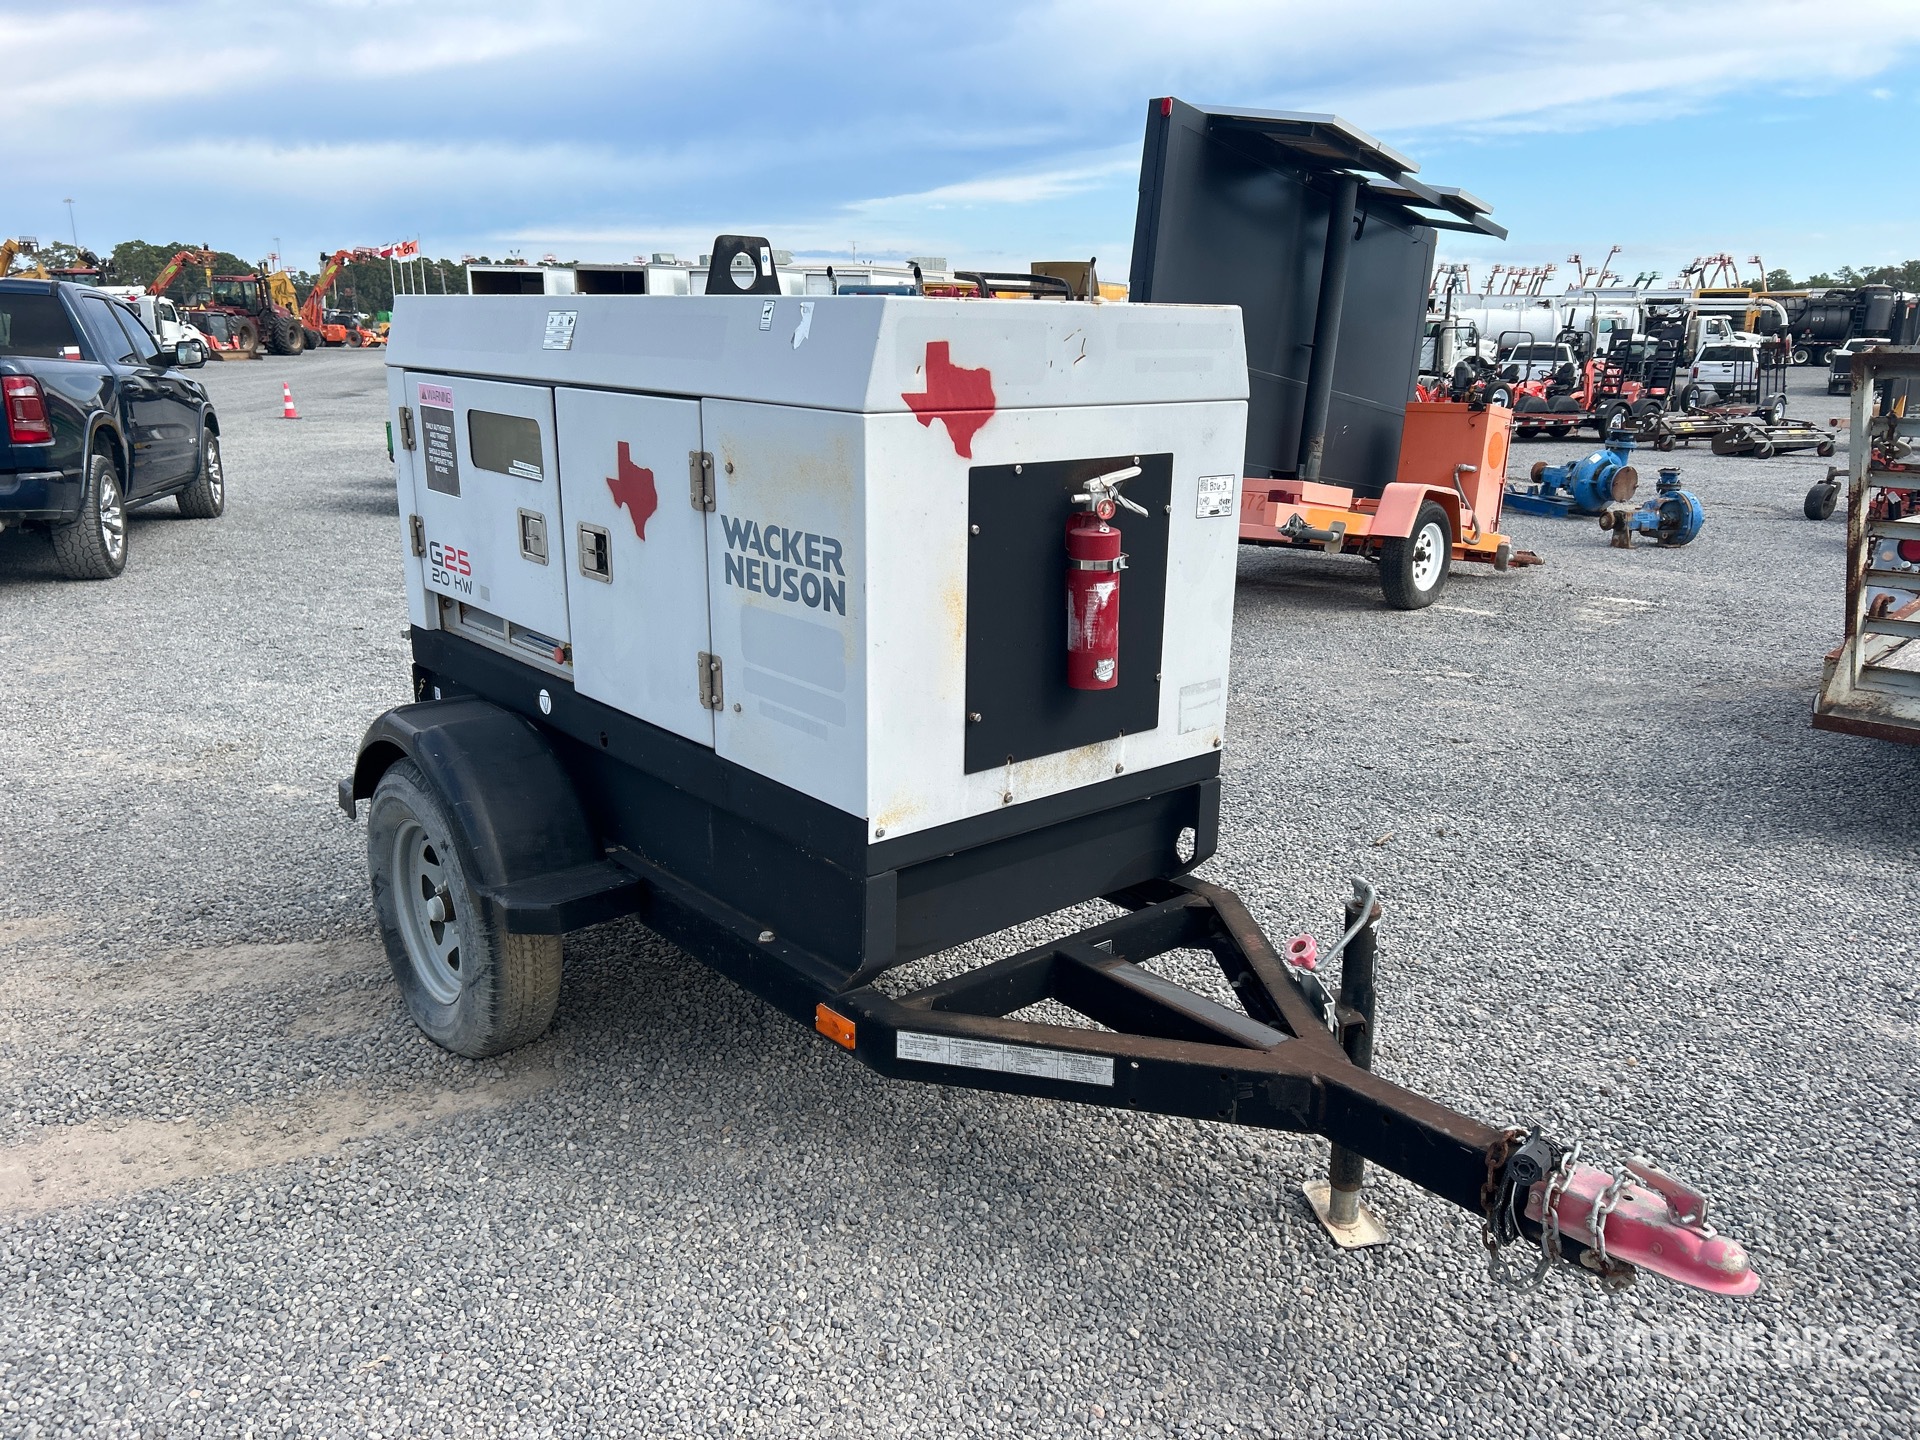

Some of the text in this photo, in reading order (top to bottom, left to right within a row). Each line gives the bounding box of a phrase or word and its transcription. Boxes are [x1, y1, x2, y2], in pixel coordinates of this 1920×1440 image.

[427, 389, 451, 404] WARNING
[429, 540, 472, 577] G25
[720, 514, 846, 577] WACKER
[431, 567, 450, 587] 20
[724, 551, 846, 617] NEUSON
